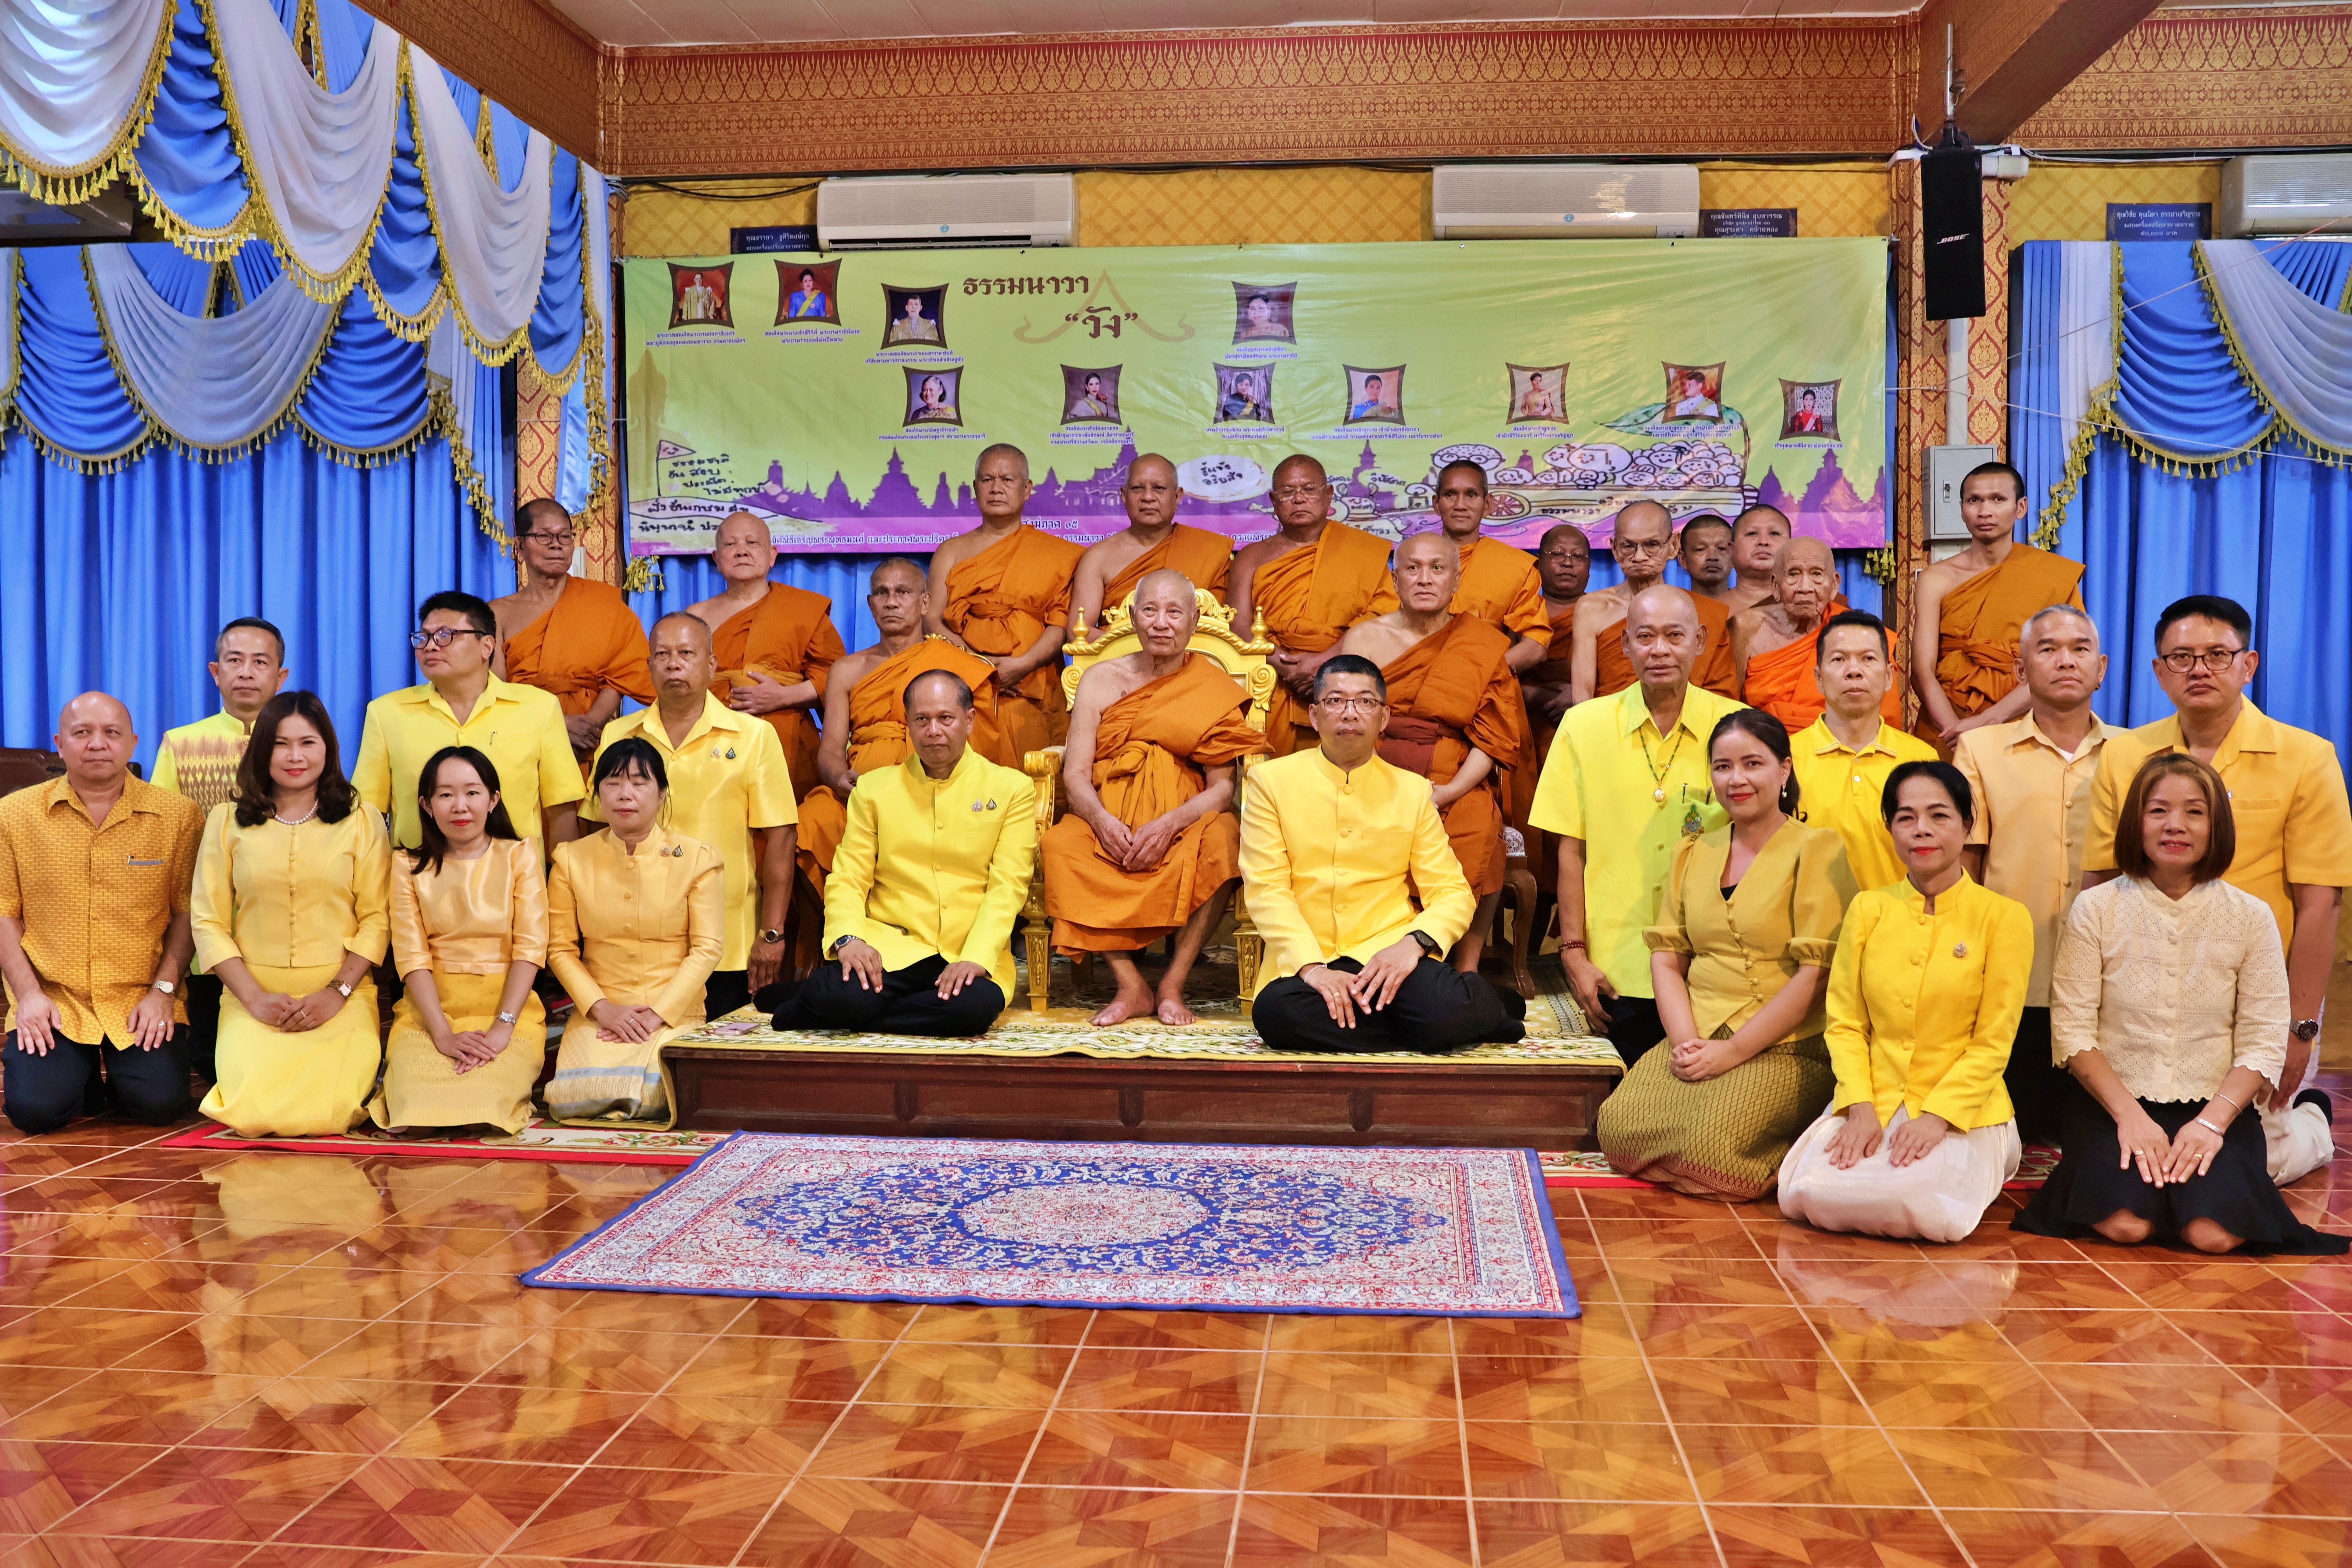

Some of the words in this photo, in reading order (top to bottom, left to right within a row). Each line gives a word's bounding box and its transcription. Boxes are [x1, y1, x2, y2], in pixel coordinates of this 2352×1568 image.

[1936, 233, 1969, 244] BOSE
[963, 276, 1089, 296] ธรรมนาวา
[1065, 520, 1078, 528] ๑๕
[771, 532, 864, 548] จัดพิธีเจริญพระพุทธมนต์
